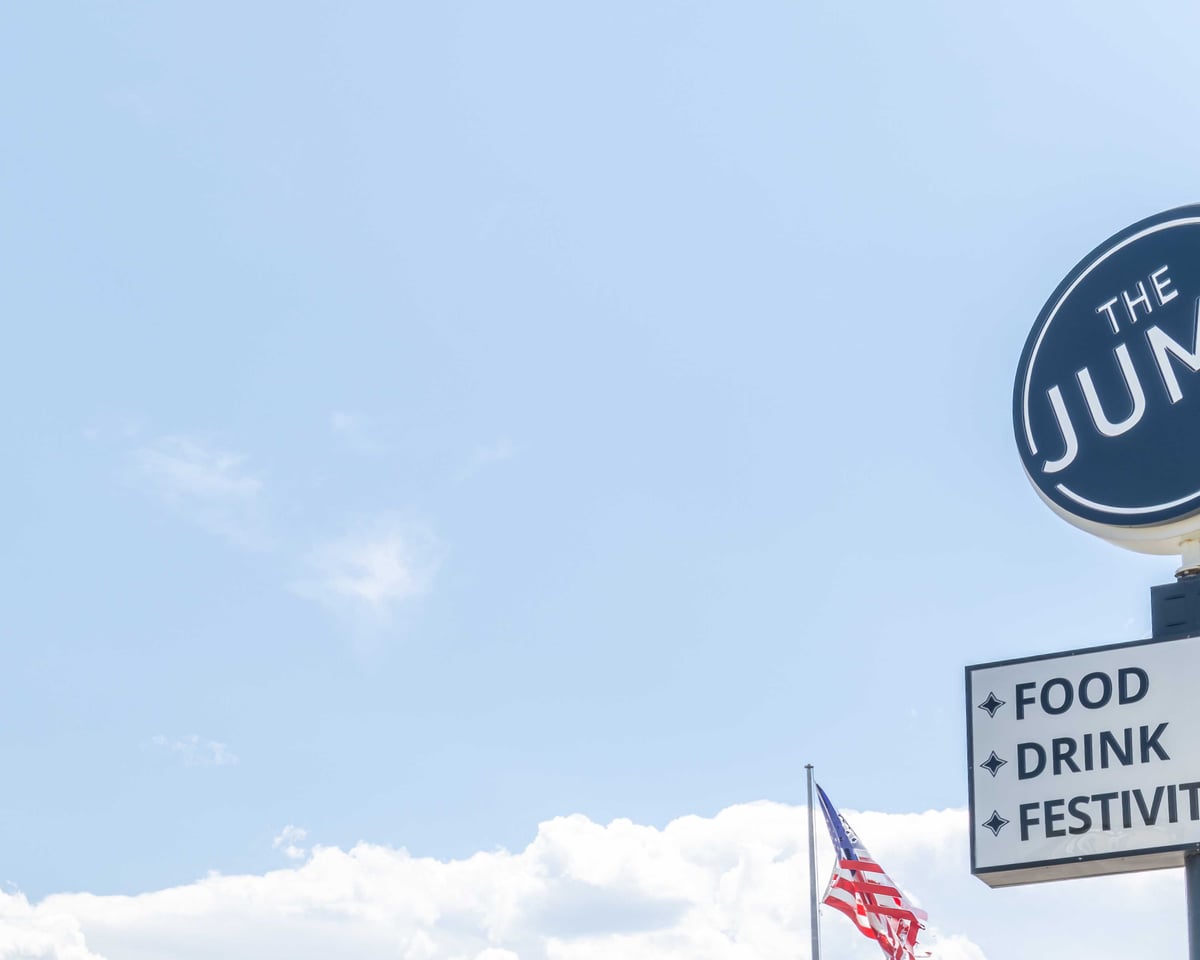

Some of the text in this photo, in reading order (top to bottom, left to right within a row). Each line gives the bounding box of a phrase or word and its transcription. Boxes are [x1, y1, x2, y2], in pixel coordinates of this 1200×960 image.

[1096, 265, 1179, 334] THE
[1015, 666, 1150, 721] FOOD
[1017, 721, 1171, 781] DRINK
[1019, 781, 1200, 842] FESTIVIT
